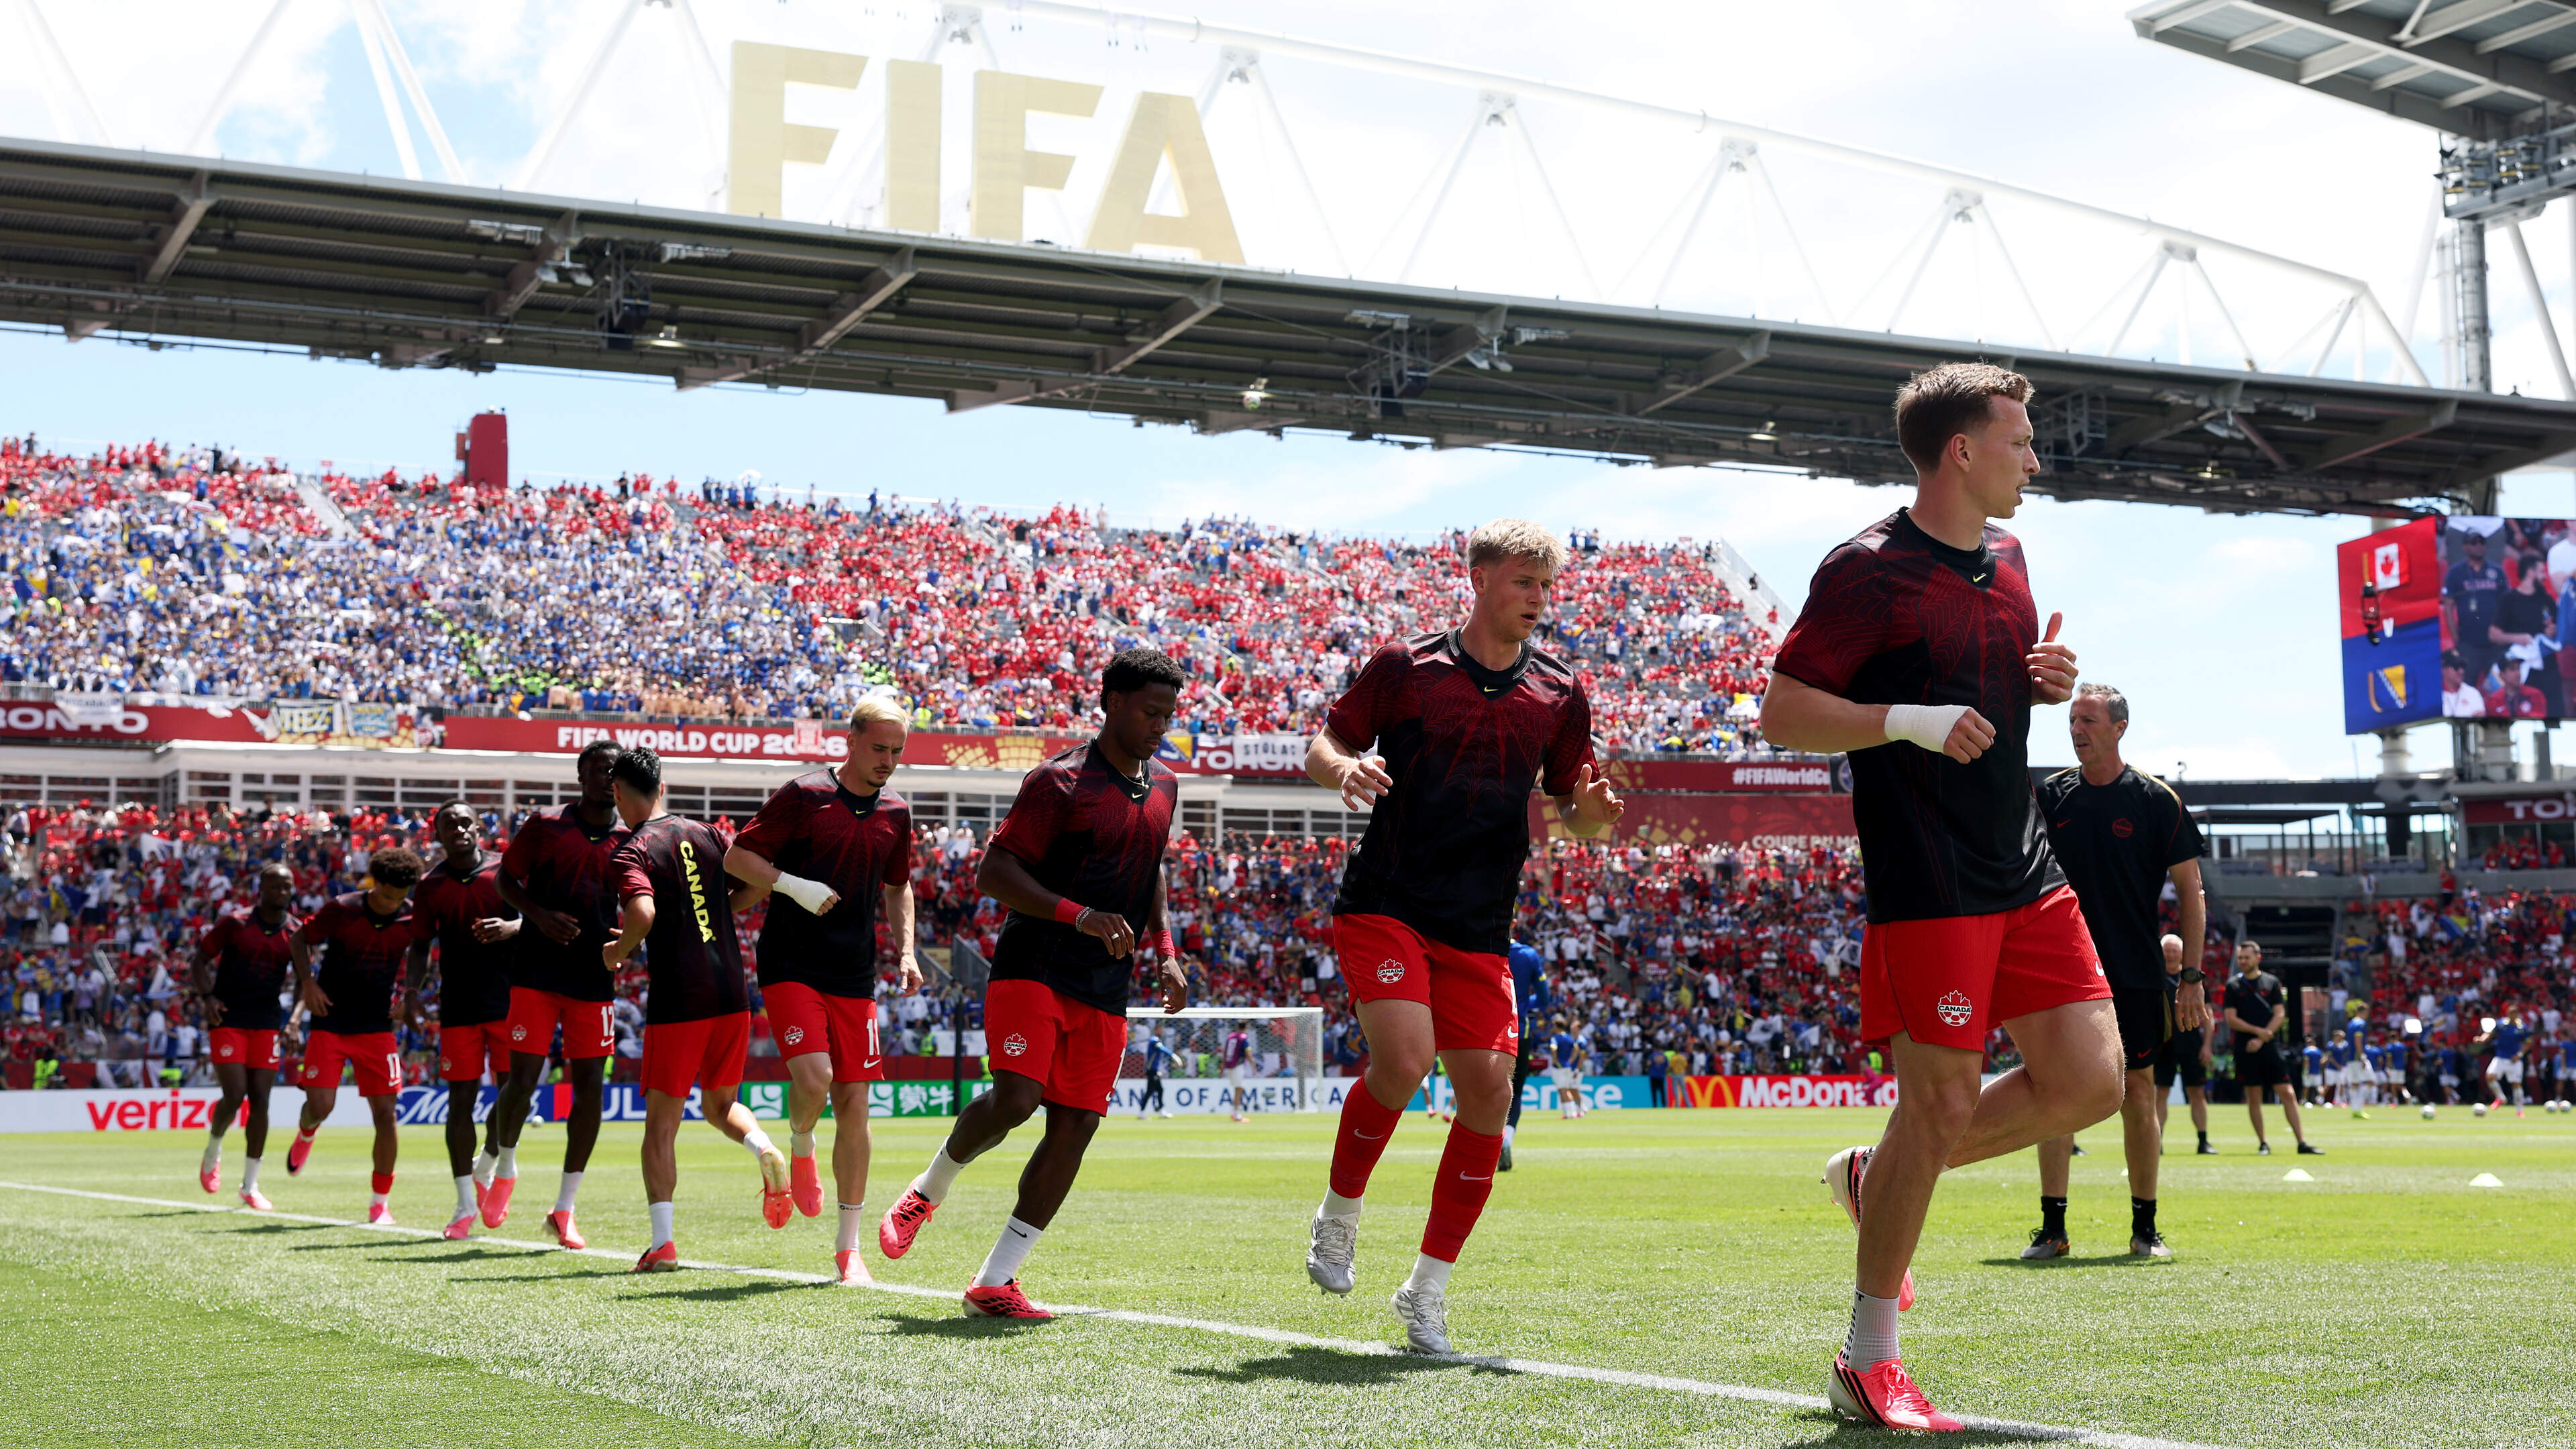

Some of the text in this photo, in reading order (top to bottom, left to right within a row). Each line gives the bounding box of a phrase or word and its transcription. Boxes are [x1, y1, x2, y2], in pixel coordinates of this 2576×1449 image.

[727, 39, 1247, 265] FIFA
[0, 706, 149, 734] ONO
[557, 727, 608, 748] FIFA
[616, 729, 706, 753] WORLD
[710, 732, 760, 754] CUP
[680, 840, 713, 943] CANADA
[1938, 1005, 1972, 1013] CANADA
[87, 1089, 251, 1131] veriz
[898, 1083, 954, 1116] 蒙牛
[1177, 1088, 1210, 1106] OF
[1219, 1087, 1343, 1106] AMERCA
